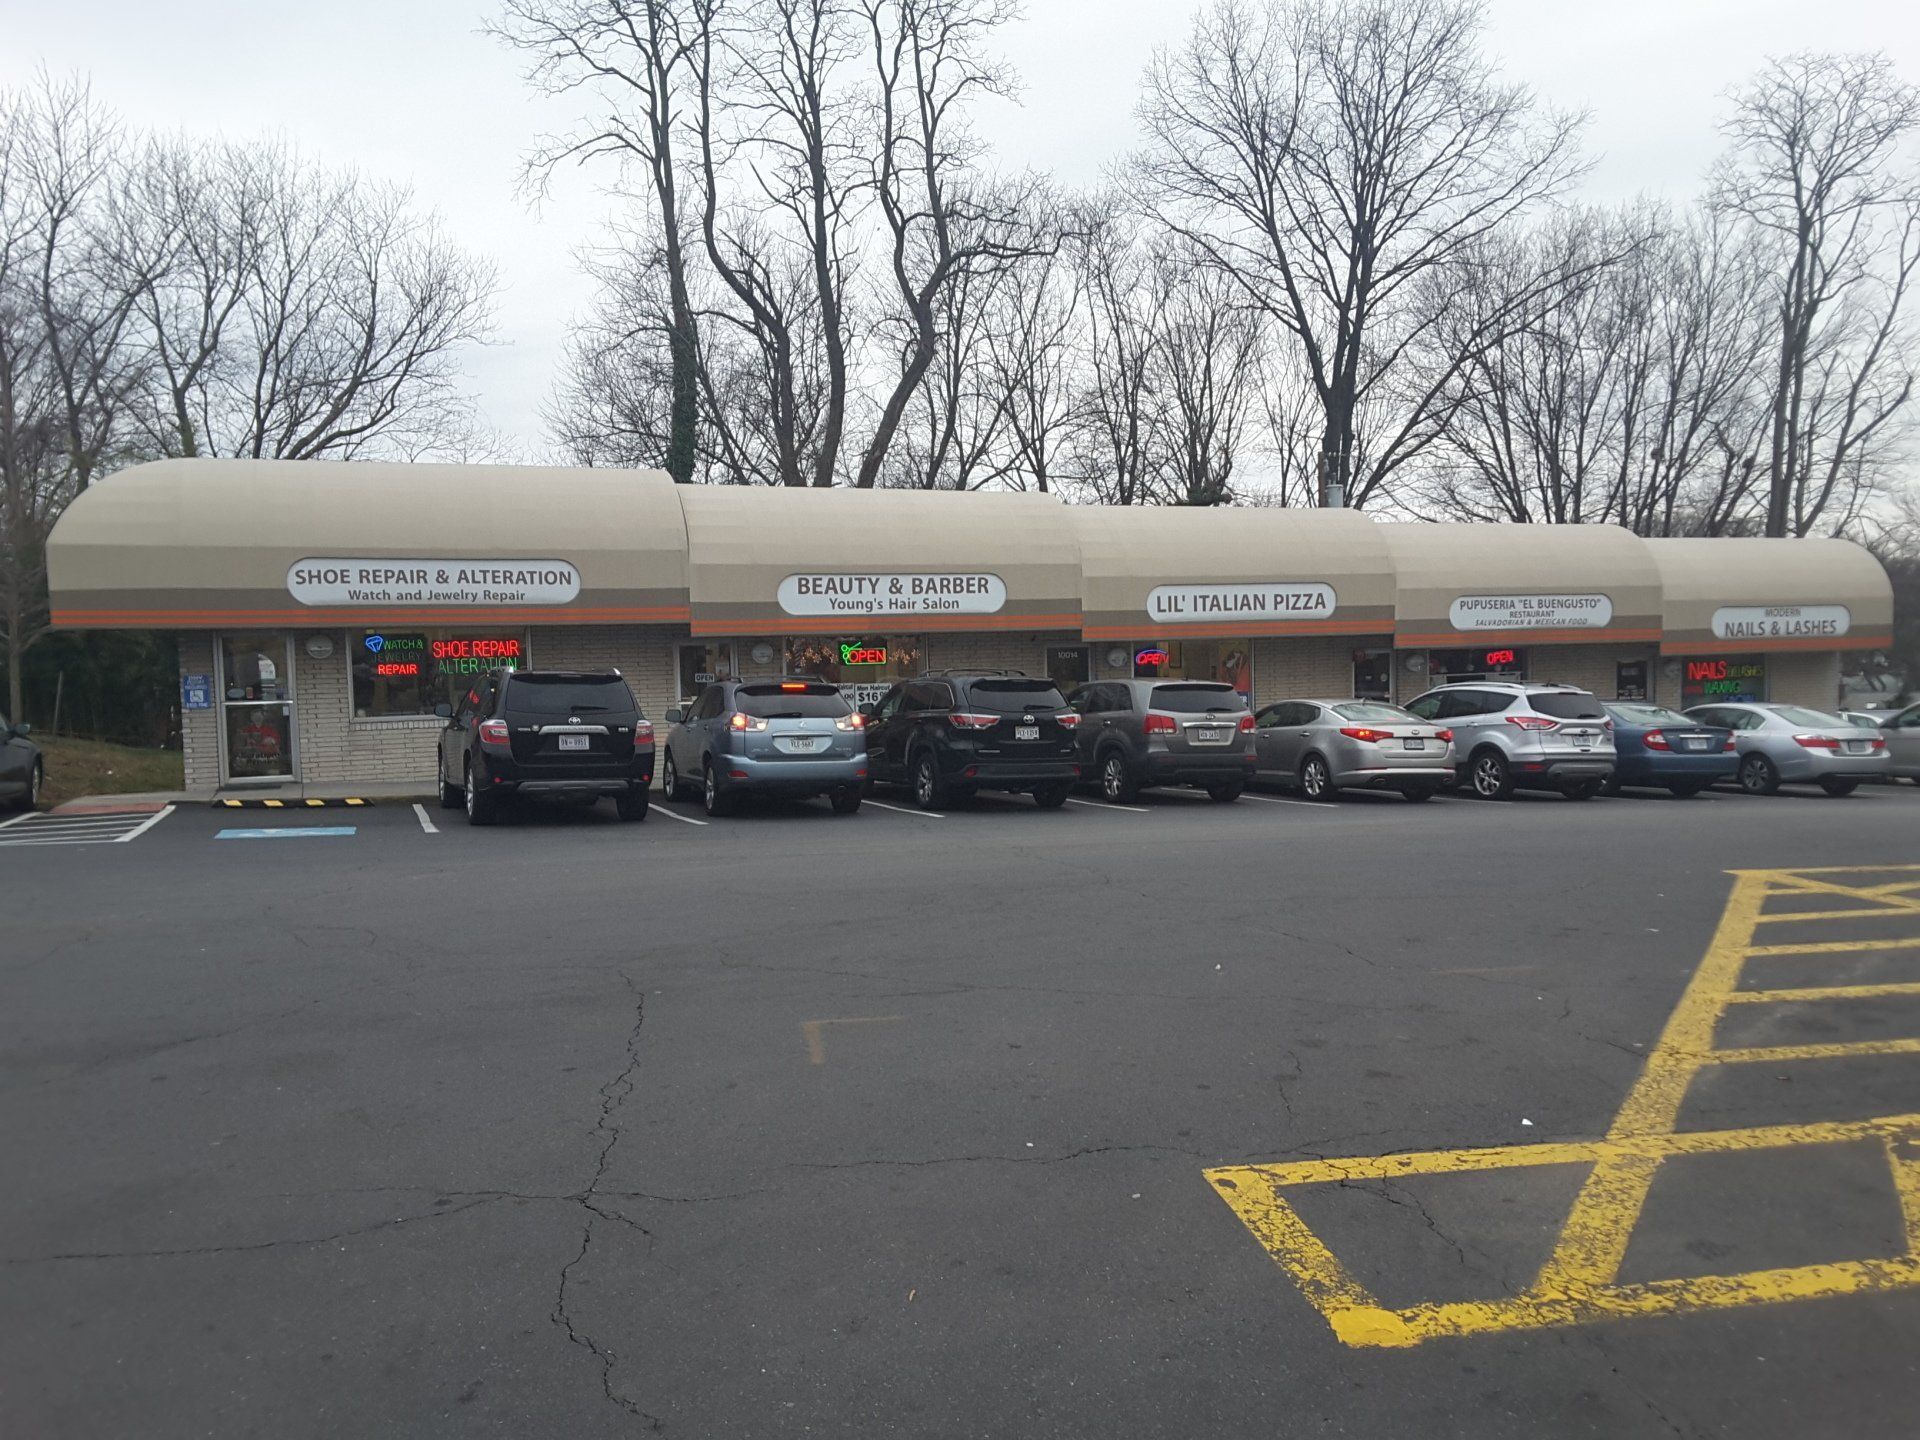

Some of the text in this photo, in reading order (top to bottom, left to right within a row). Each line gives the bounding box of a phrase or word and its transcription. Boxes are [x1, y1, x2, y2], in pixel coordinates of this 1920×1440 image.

[294, 569, 572, 585] SHOE REPAIR & ALTERATION
[797, 577, 989, 594] BEAUTY & BARBER
[347, 589, 526, 602] Watch and Jewelry Repair
[1157, 592, 1326, 613] LIL' ITALIAN PIZZA
[829, 597, 960, 612] Young's Hair Salon
[1460, 600, 1516, 610] PUPUSERIA
[1509, 611, 1555, 619] RESTAURANT
[1764, 608, 1801, 617] MODERN
[1725, 620, 1837, 637] NAILS & LASHES
[384, 640, 415, 650] WATCH
[432, 640, 520, 658] SHOE REPAIR
[849, 650, 886, 663] OPEN
[1137, 653, 1169, 665] OPEN
[1487, 650, 1514, 665] OPEN
[377, 663, 418, 675] REPAIR
[438, 656, 518, 675] ALTERATION
[1687, 661, 1727, 680] NAILS
[695, 674, 714, 682] OPEN
